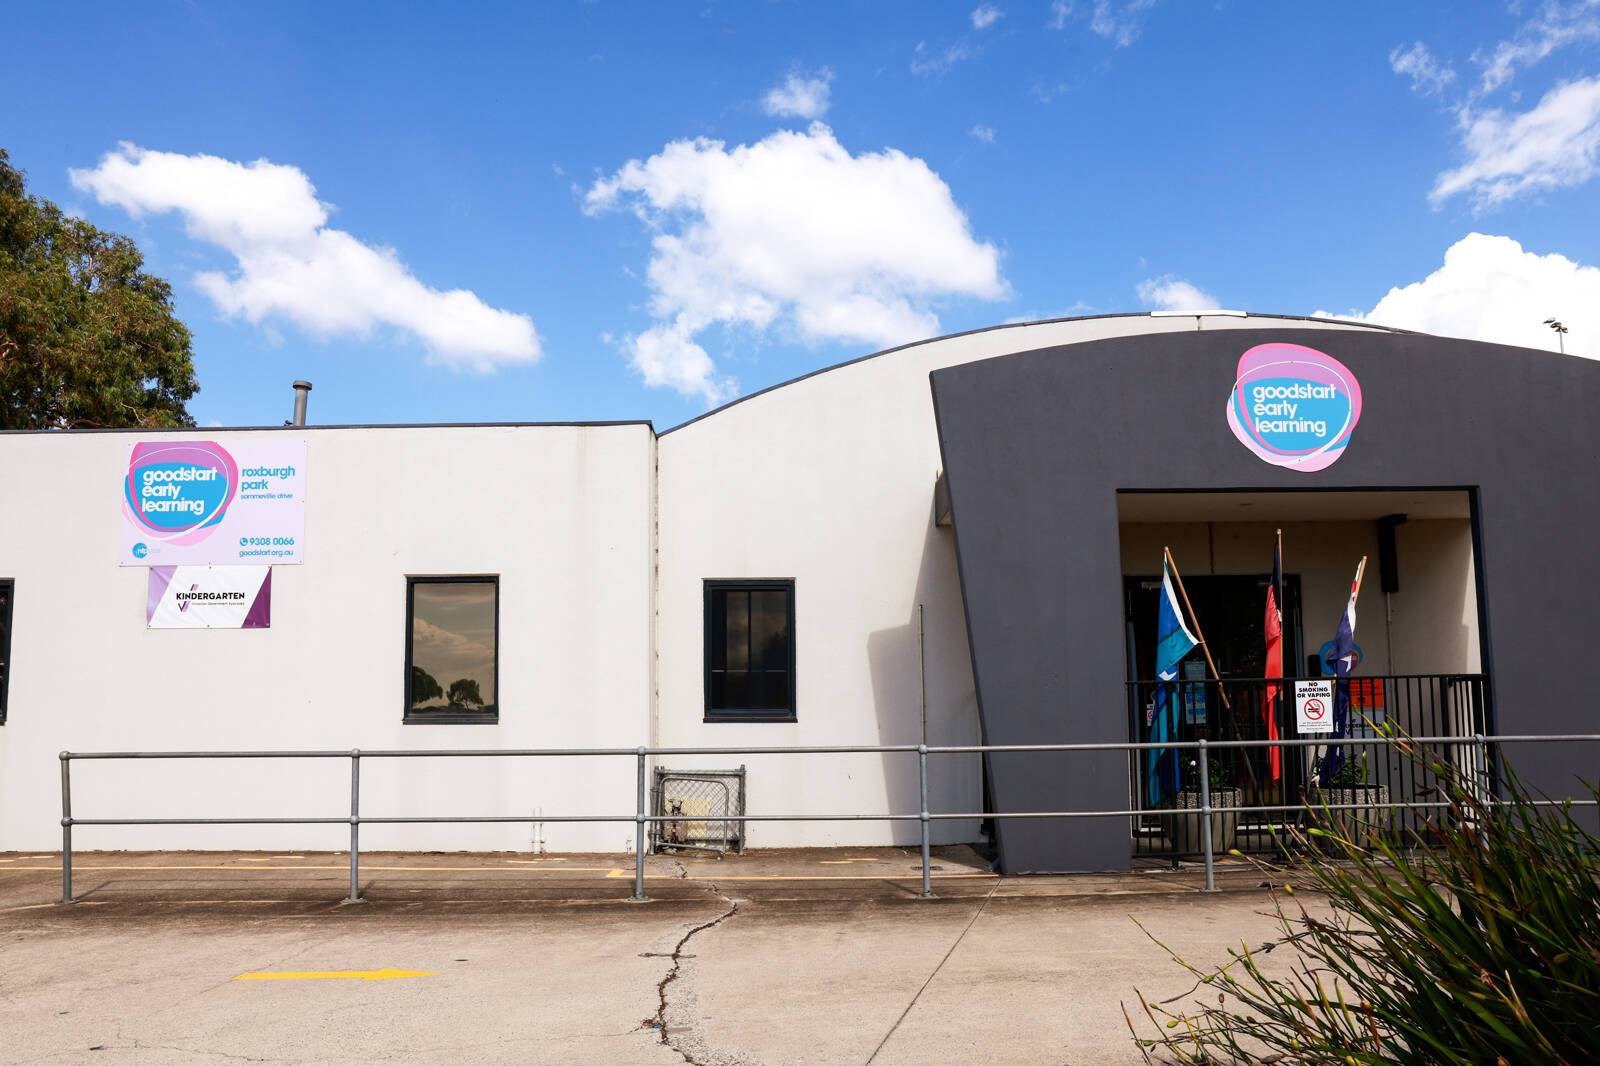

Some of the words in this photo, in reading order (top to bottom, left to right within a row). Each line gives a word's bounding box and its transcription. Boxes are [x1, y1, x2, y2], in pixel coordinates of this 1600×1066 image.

[1253, 384, 1336, 402] goodstart
[1253, 401, 1298, 419] early
[1255, 417, 1326, 437] learning
[143, 466, 217, 485] goodstart
[242, 465, 295, 479] roxburgh
[142, 482, 181, 499] early
[241, 479, 269, 492] park
[142, 497, 204, 515] learning
[249, 537, 271, 546] 9308
[272, 537, 295, 546] 0066
[239, 549, 293, 557] goodstart.org.au
[176, 592, 245, 600] KINDERGARTEN
